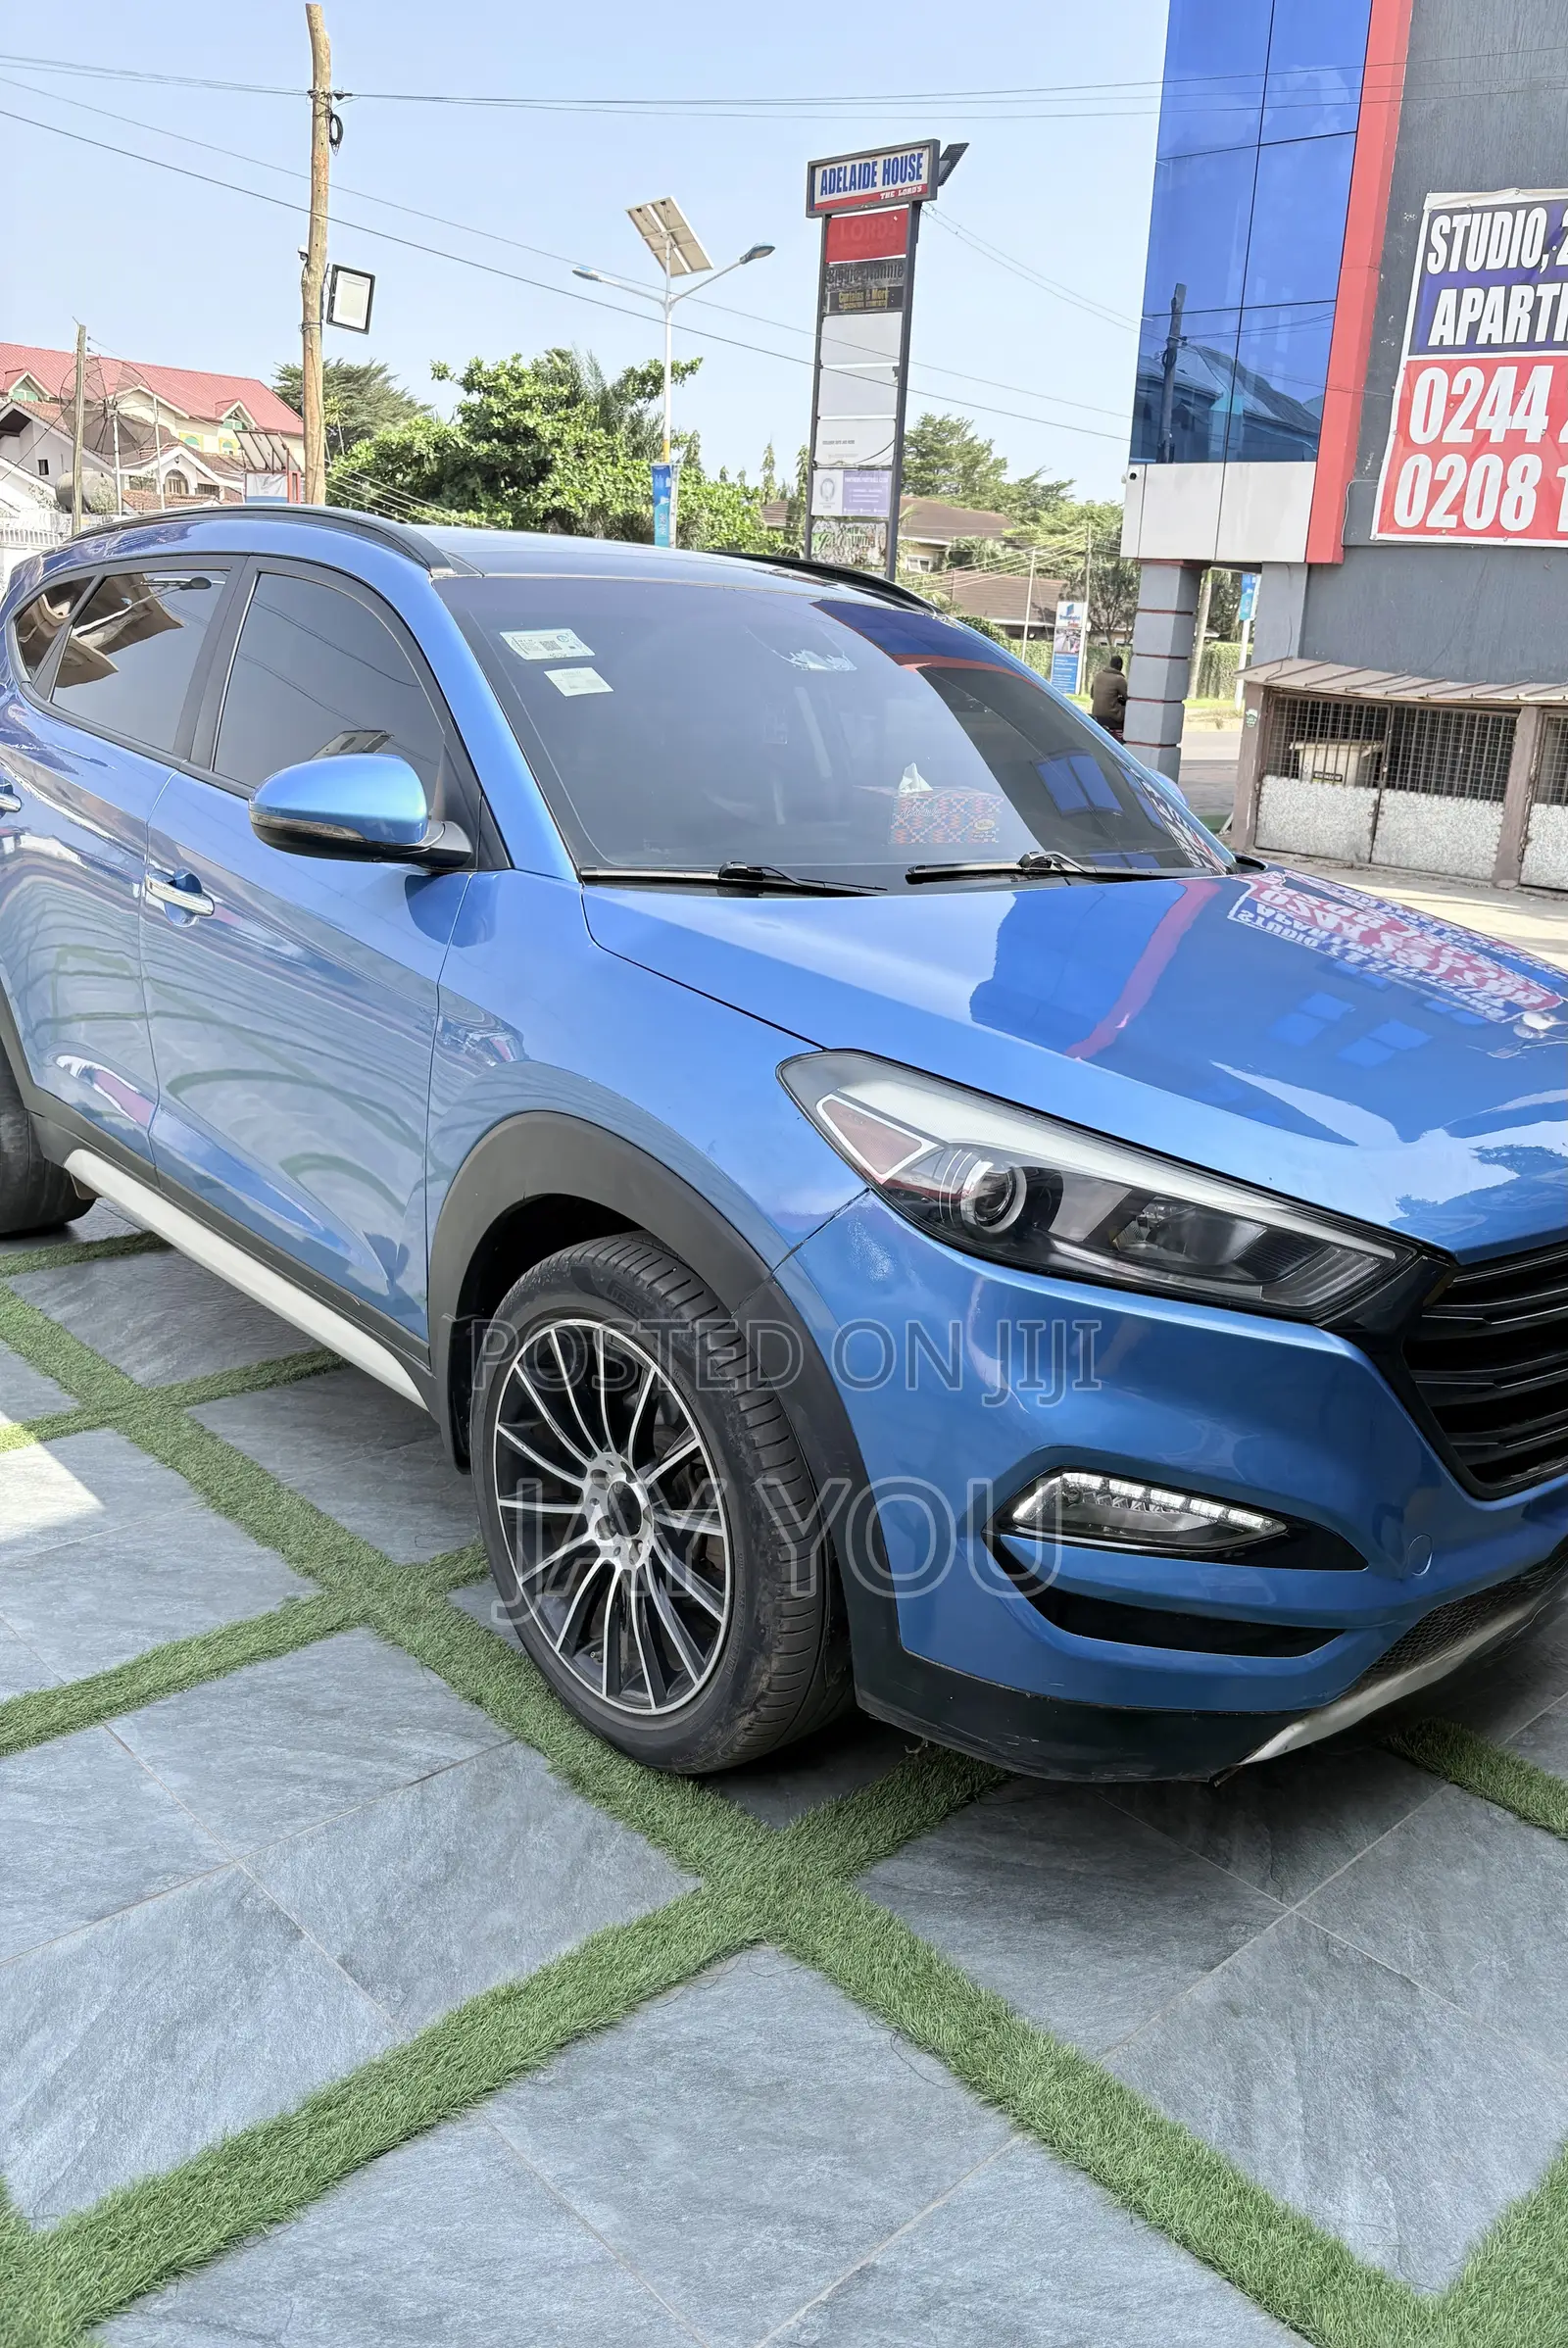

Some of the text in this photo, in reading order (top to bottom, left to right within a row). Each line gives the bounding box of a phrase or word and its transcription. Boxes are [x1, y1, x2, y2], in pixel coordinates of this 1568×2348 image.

[820, 152, 923, 196] ADELAIDE HOUSE
[880, 191, 896, 200] THE
[1427, 206, 1549, 275] STUDIO,
[1409, 365, 1554, 445] 0244
[1394, 453, 1543, 532] 0208
